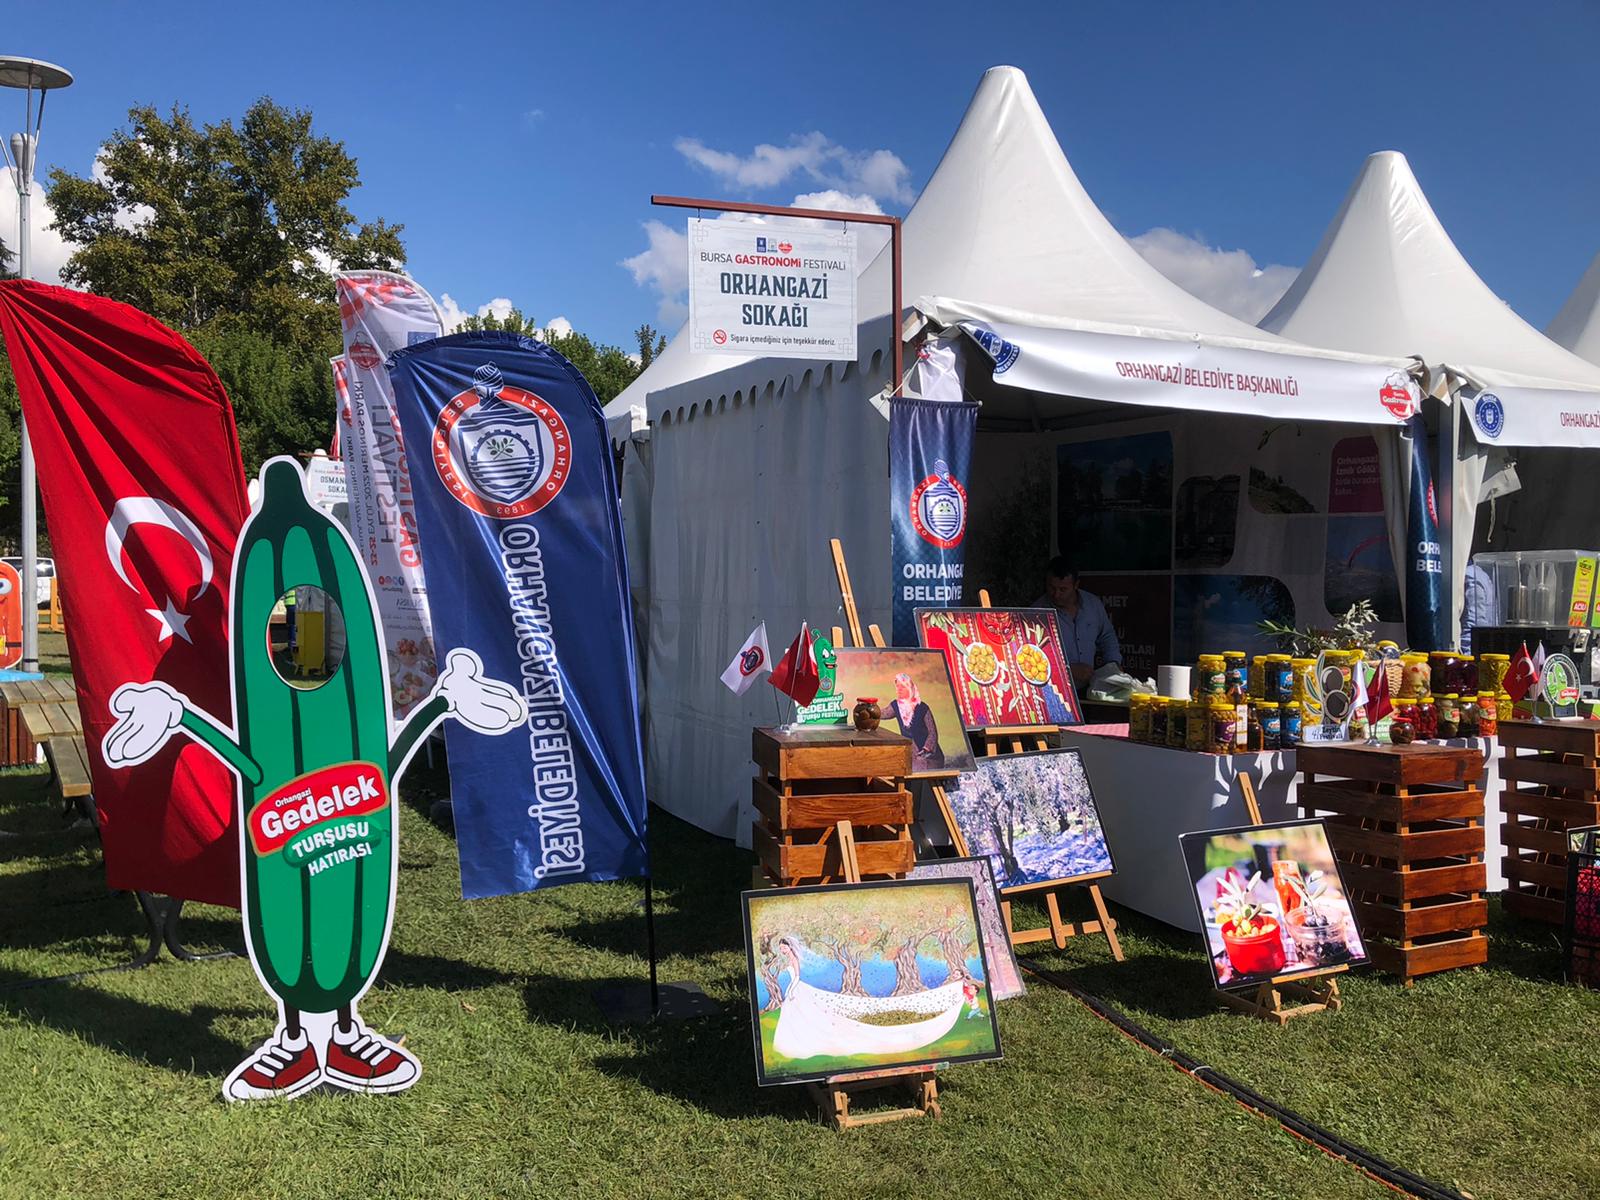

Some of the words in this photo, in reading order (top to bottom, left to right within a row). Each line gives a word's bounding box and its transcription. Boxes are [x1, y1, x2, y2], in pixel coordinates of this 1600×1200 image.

[700, 252, 733, 263] BURSA
[720, 272, 828, 300] ORHANGAZİ
[742, 302, 808, 328] SOKAĞI
[730, 334, 749, 344] Sigara
[782, 336, 793, 345] için
[1115, 361, 1183, 384] ORHANGAZİ
[1184, 367, 1235, 390] BELEDİYE
[1237, 373, 1299, 397] BAŞKANLIĞI
[320, 476, 346, 485] OSMAN
[328, 486, 347, 494] SOKA
[902, 563, 964, 579] ORHANGA
[796, 701, 841, 714] GEDELEK
[260, 775, 380, 839] Gedelek
[275, 787, 312, 808] Orhangazi
[291, 821, 369, 859] TURŞUSU
[307, 842, 373, 877] HATIRASI
